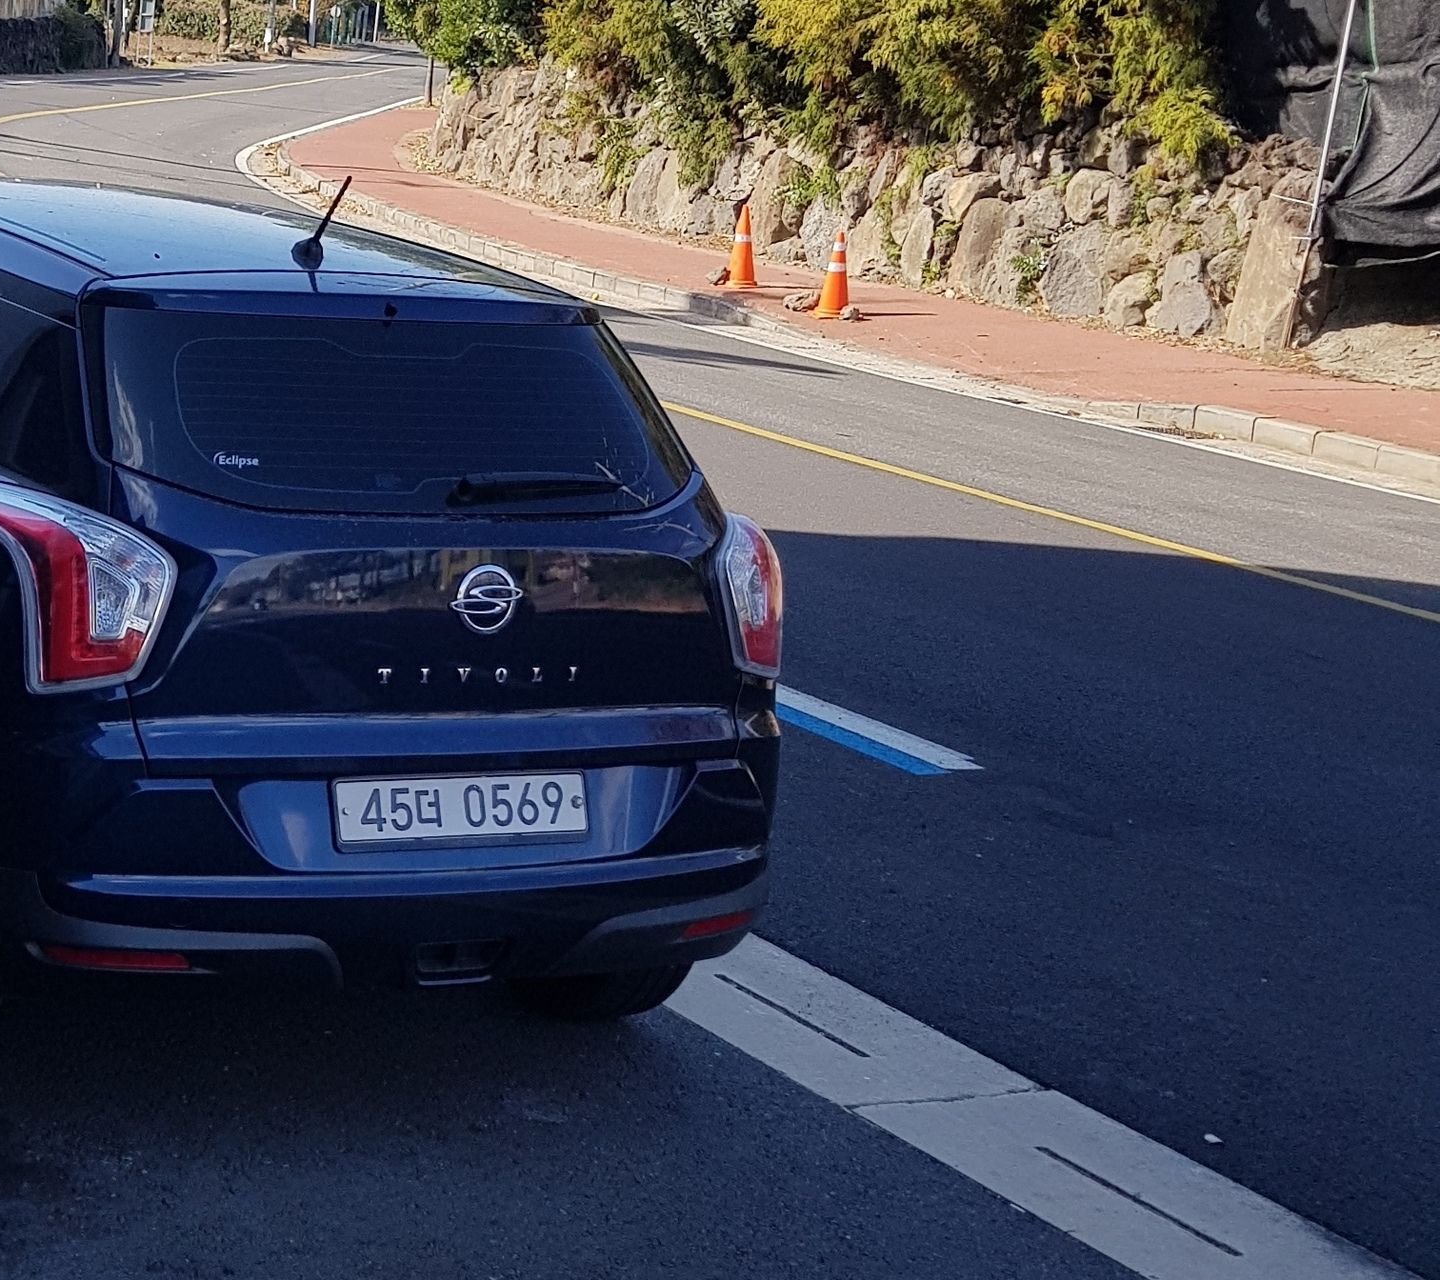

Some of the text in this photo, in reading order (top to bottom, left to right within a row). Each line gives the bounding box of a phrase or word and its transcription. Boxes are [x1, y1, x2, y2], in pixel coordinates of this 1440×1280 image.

[217, 454, 260, 470] Eclipse
[377, 665, 578, 685] TIVOLI
[360, 780, 566, 833] 45더 0569
